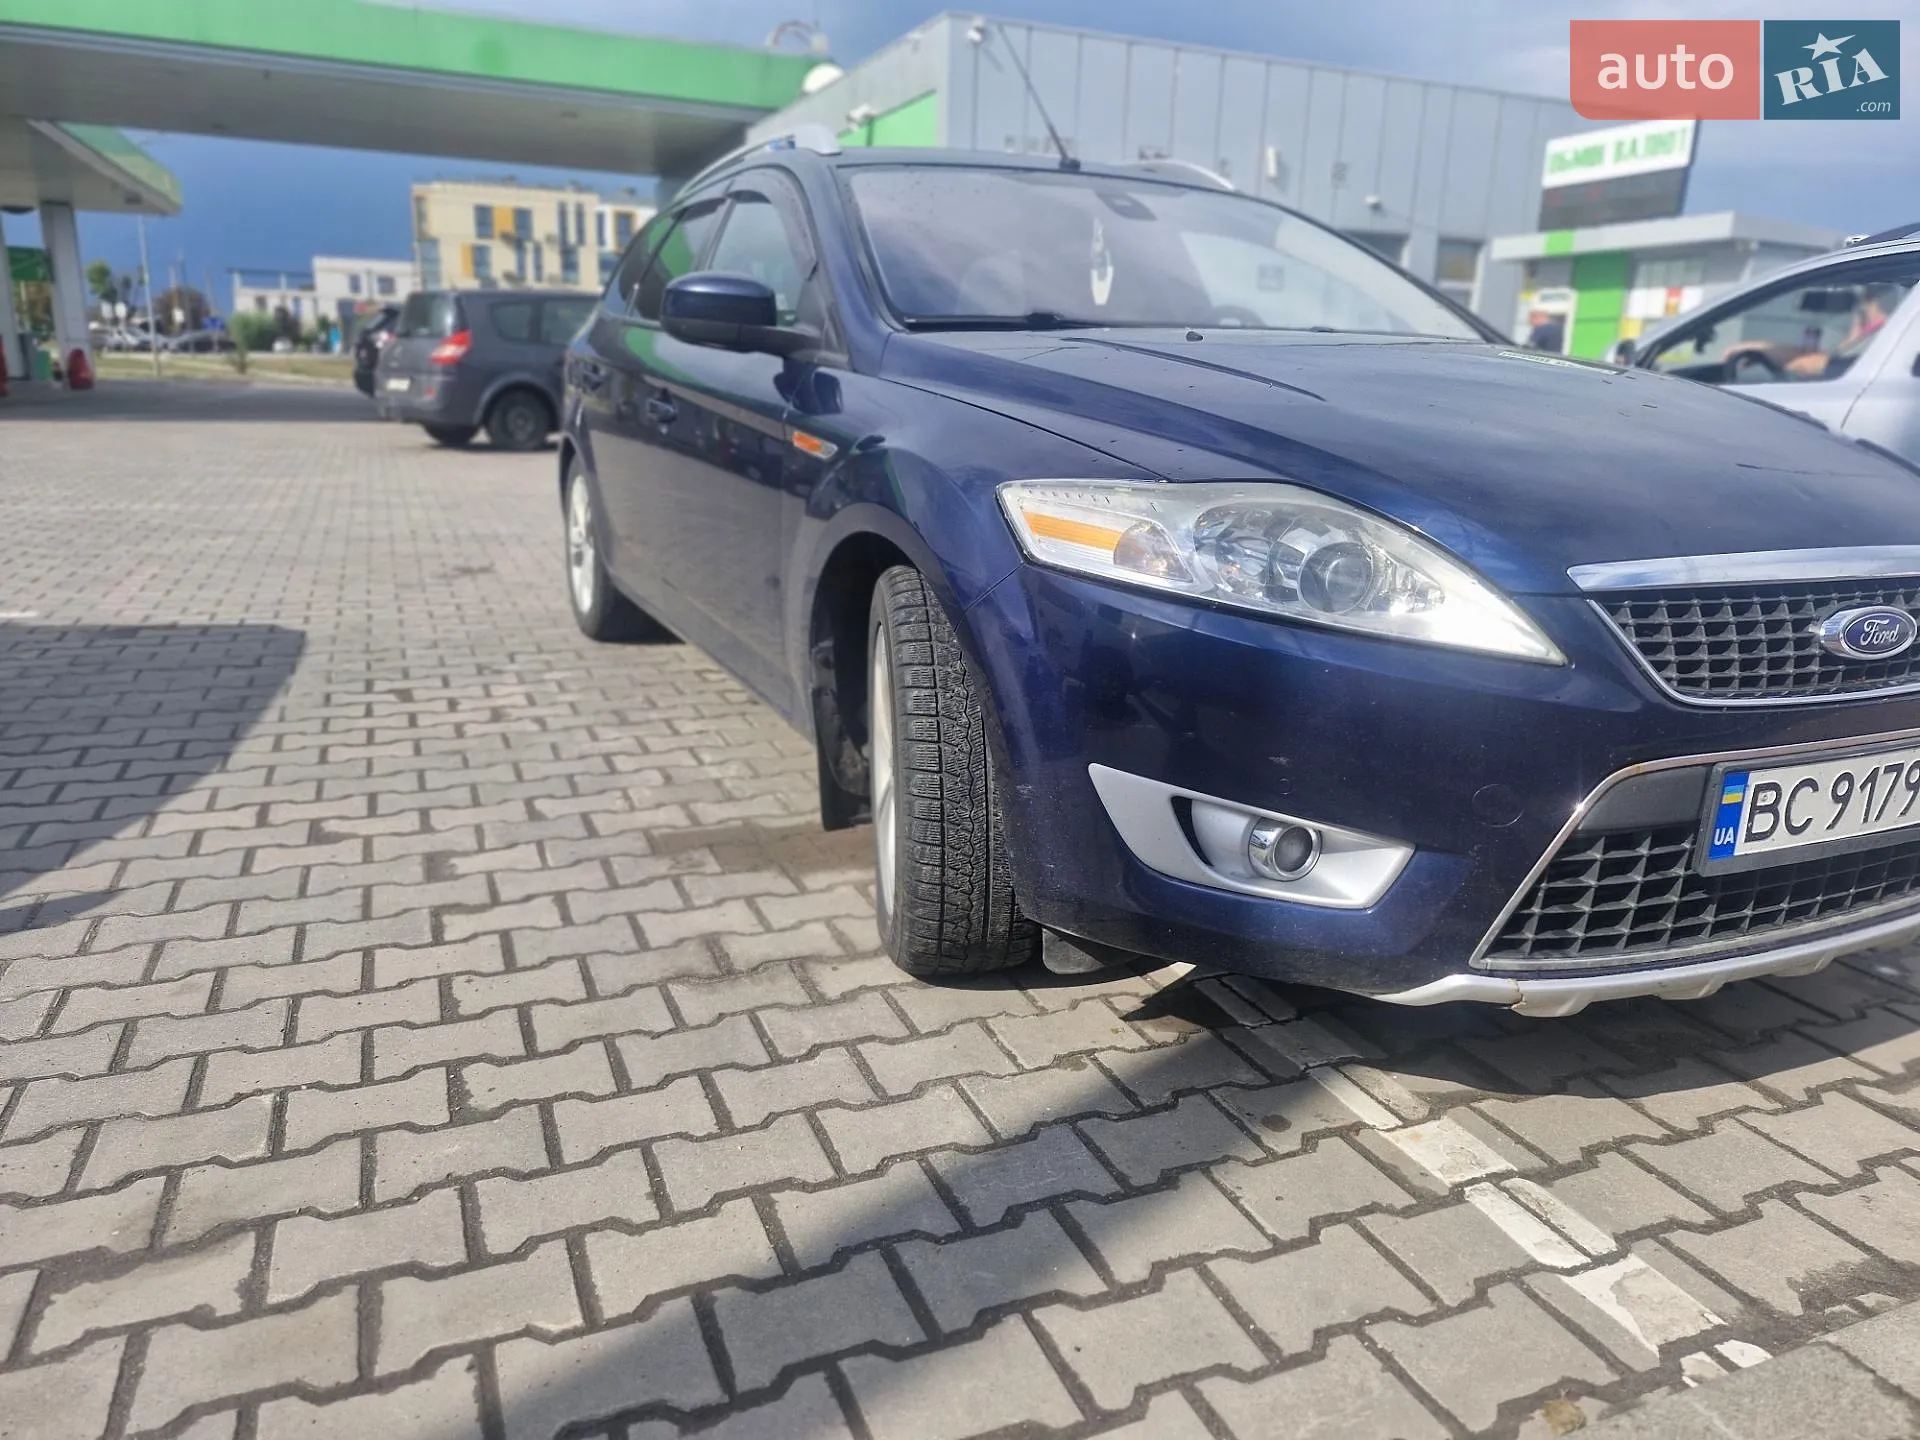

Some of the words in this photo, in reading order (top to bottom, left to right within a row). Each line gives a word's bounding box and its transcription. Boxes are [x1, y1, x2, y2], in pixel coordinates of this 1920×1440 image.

[1859, 618, 1900, 646] Ford
[1743, 777, 1819, 844] BC
[1825, 759, 1920, 831] 9179
[1713, 825, 1735, 847] UA
